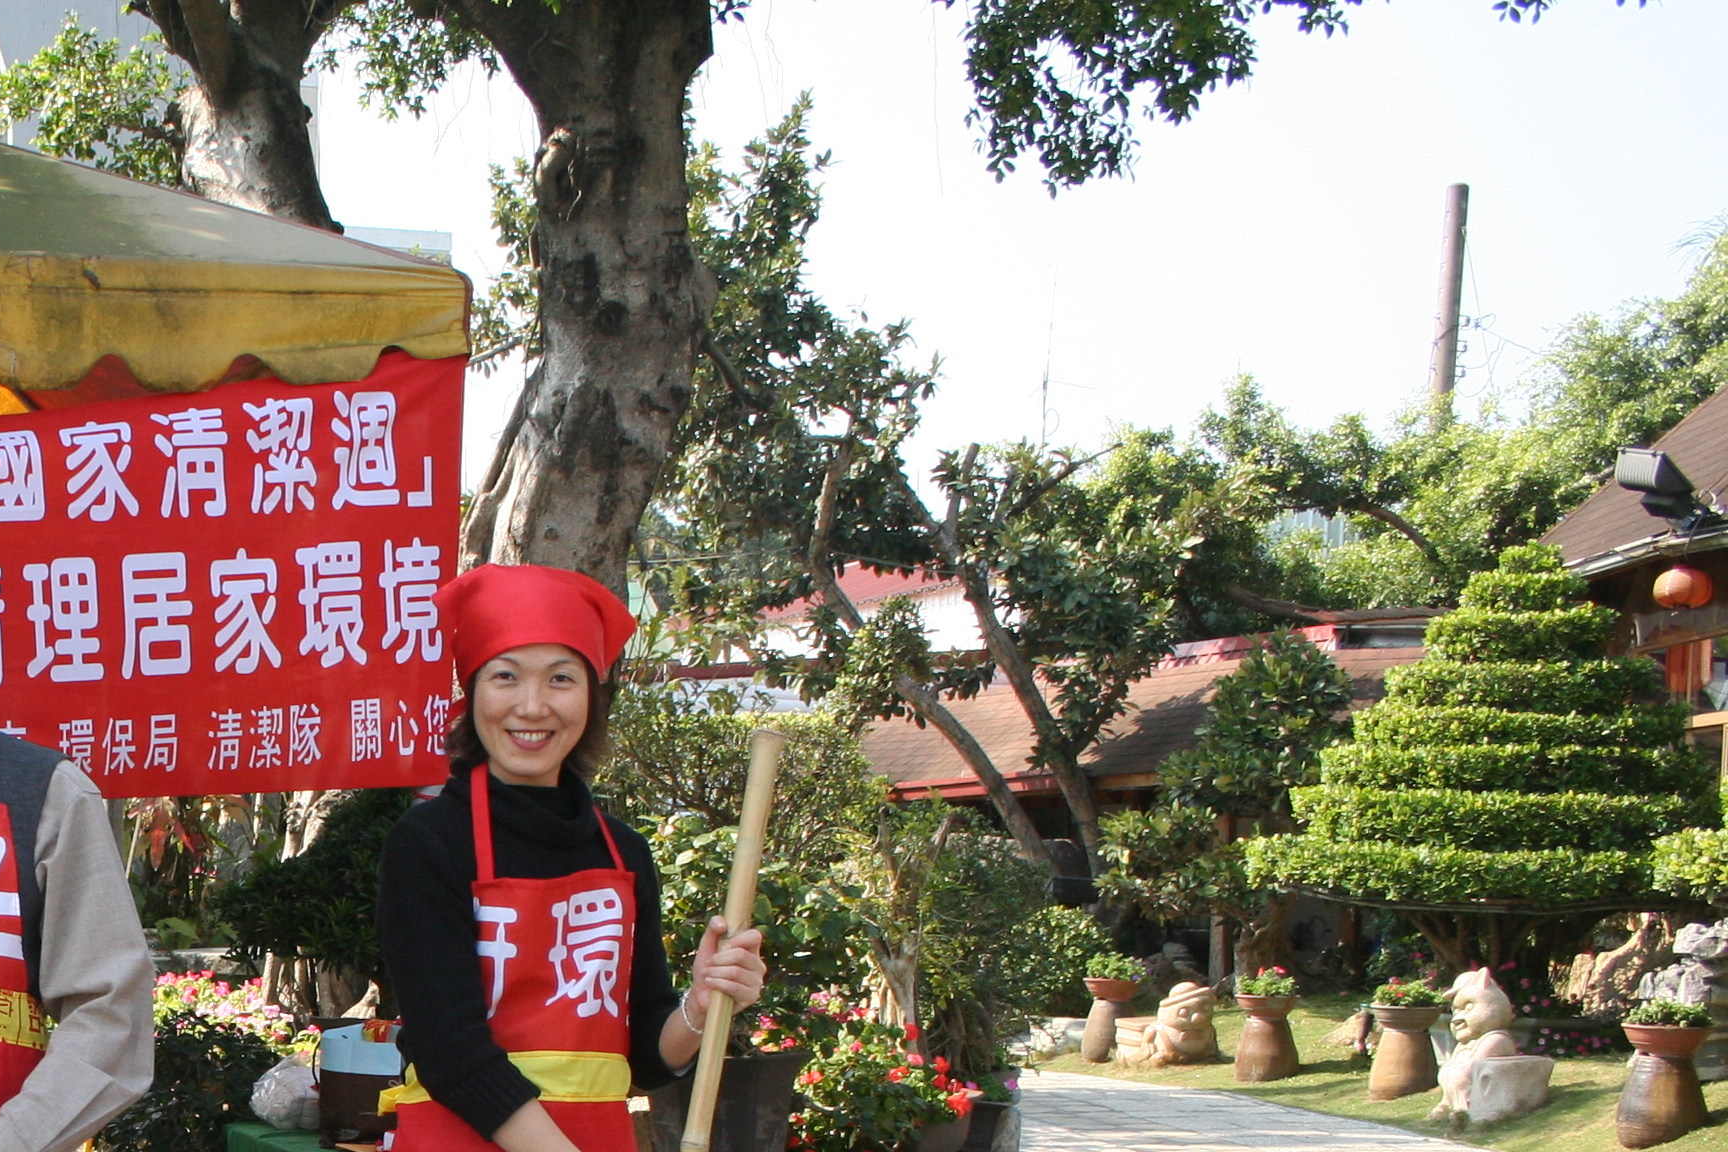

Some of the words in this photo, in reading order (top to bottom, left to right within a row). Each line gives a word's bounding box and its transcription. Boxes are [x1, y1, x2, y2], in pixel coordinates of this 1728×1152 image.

[58, 713, 179, 775] 環保局
[208, 702, 323, 770] 清潔隊
[349, 693, 448, 762] 關心您
